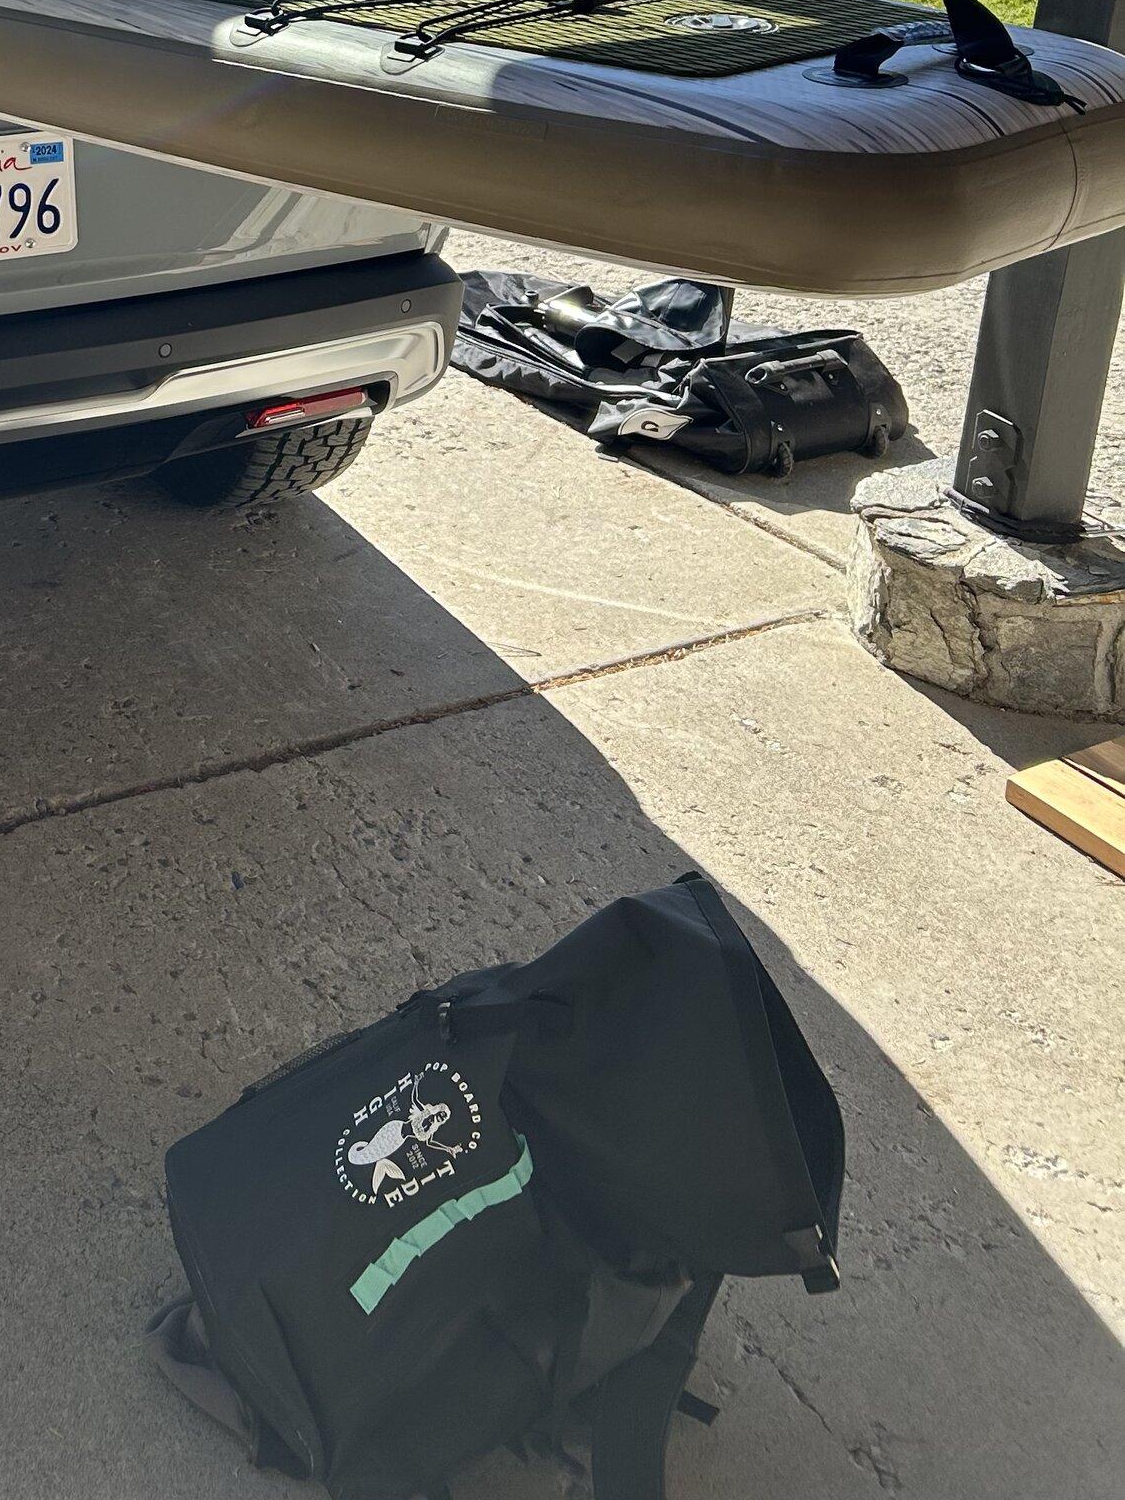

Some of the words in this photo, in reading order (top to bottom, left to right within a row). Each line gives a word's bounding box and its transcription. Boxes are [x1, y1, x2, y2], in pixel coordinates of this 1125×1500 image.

[35, 144, 58, 156] 2024
[353, 1072, 413, 1126] HIGH
[425, 1061, 449, 1072] POP
[451, 1072, 482, 1124] BOARD
[335, 1128, 377, 1205] COLLECTION
[406, 1150, 420, 1170] 2012
[411, 1143, 428, 1168] SINCE
[384, 1160, 455, 1208] TIDE
